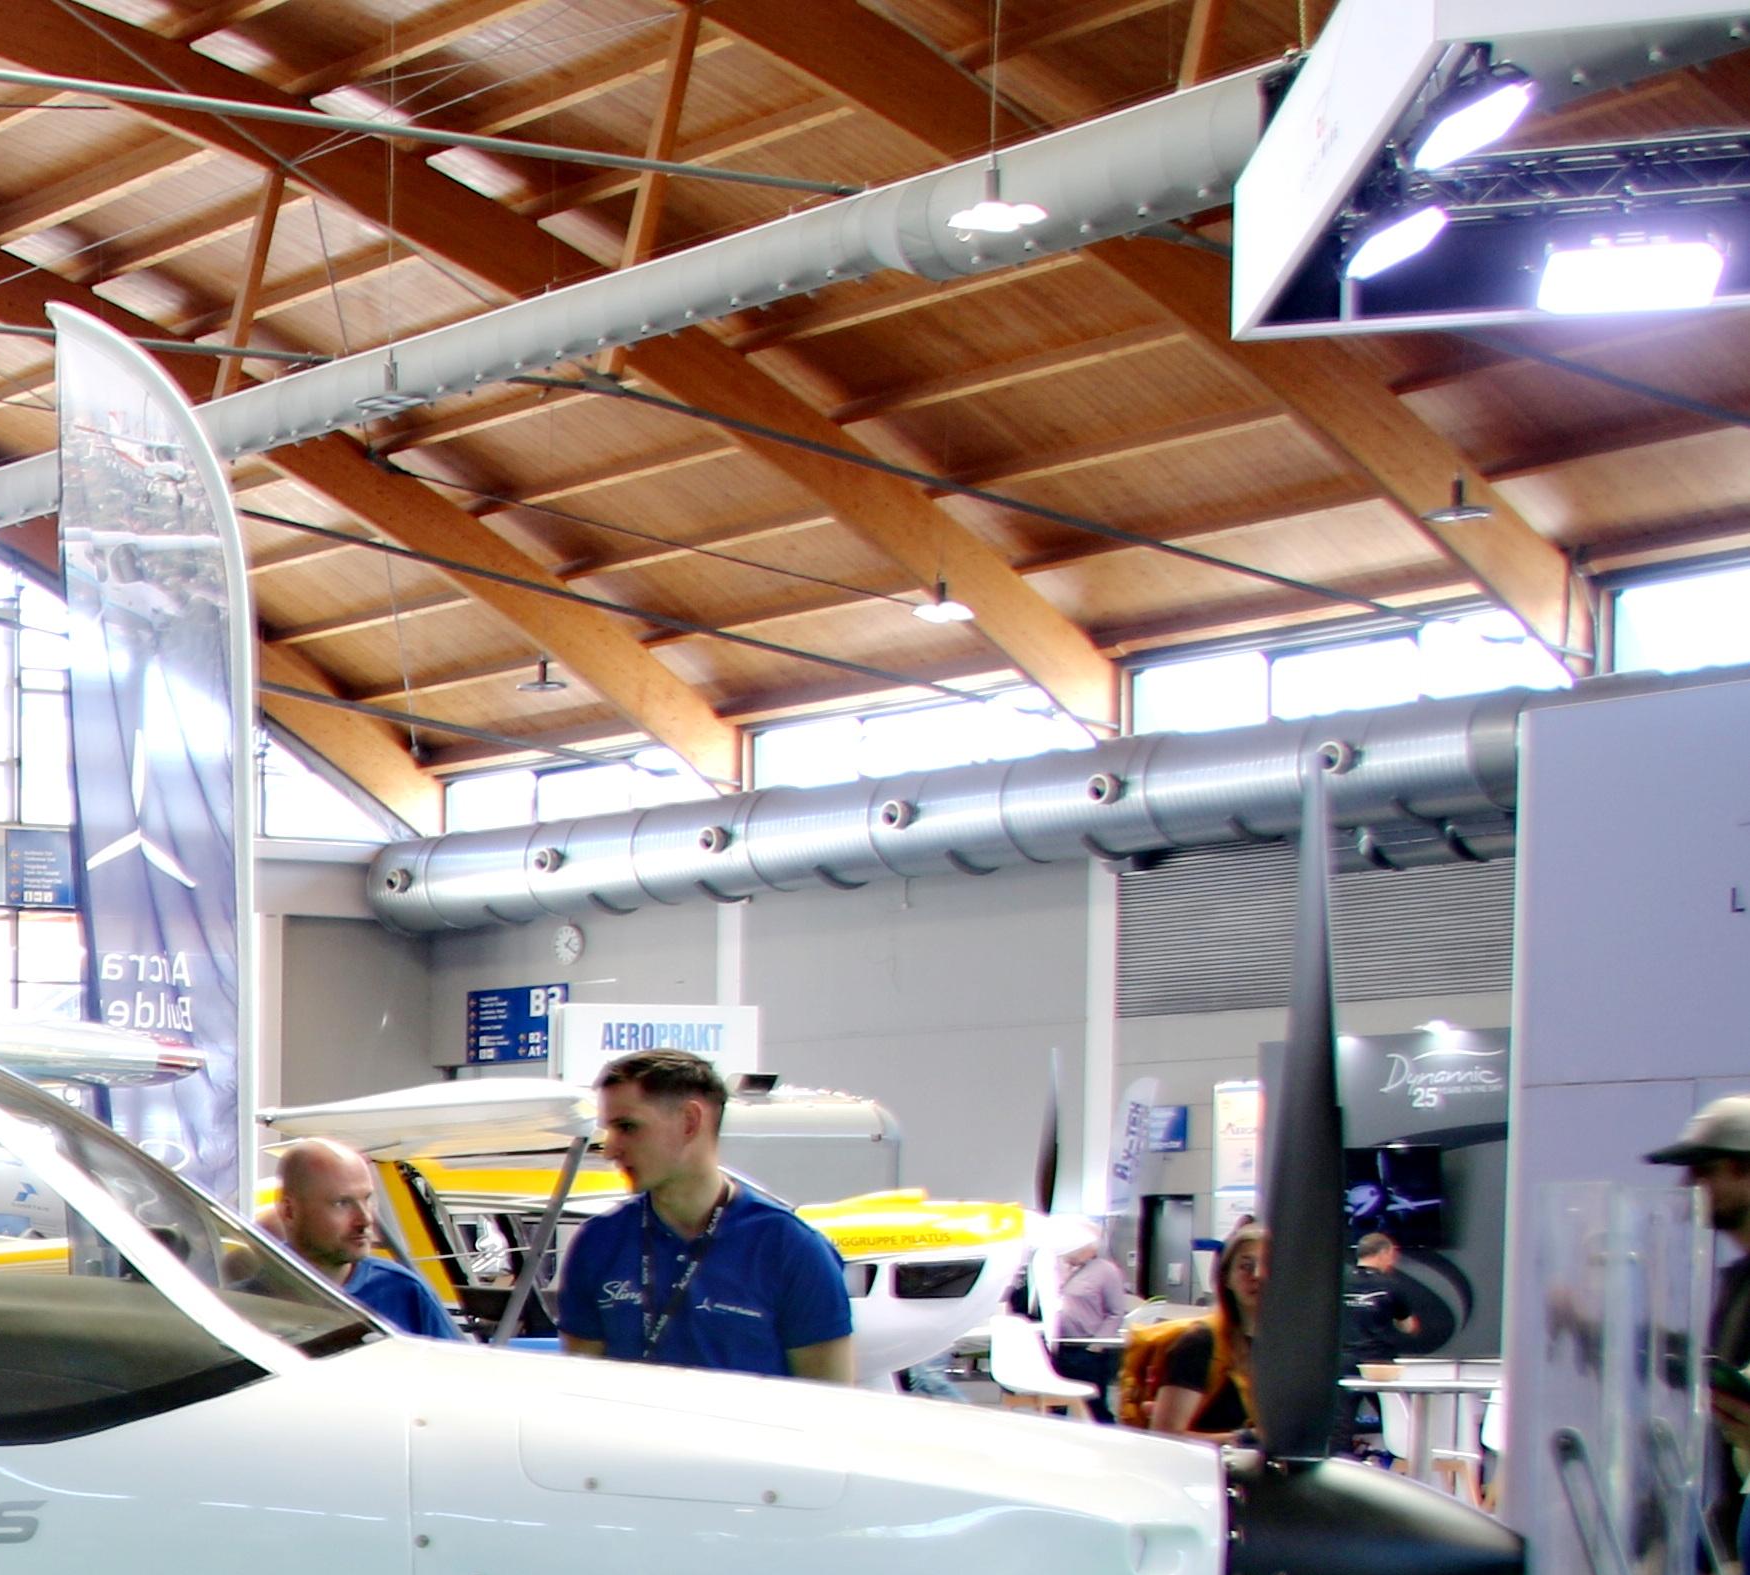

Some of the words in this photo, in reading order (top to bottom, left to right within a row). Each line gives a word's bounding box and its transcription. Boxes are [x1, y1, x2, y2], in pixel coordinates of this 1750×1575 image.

[601, 1022, 723, 1051] AEROPRAKT
[1380, 1053, 1502, 1096] Dynamic
[1412, 1087, 1439, 1108] 25
